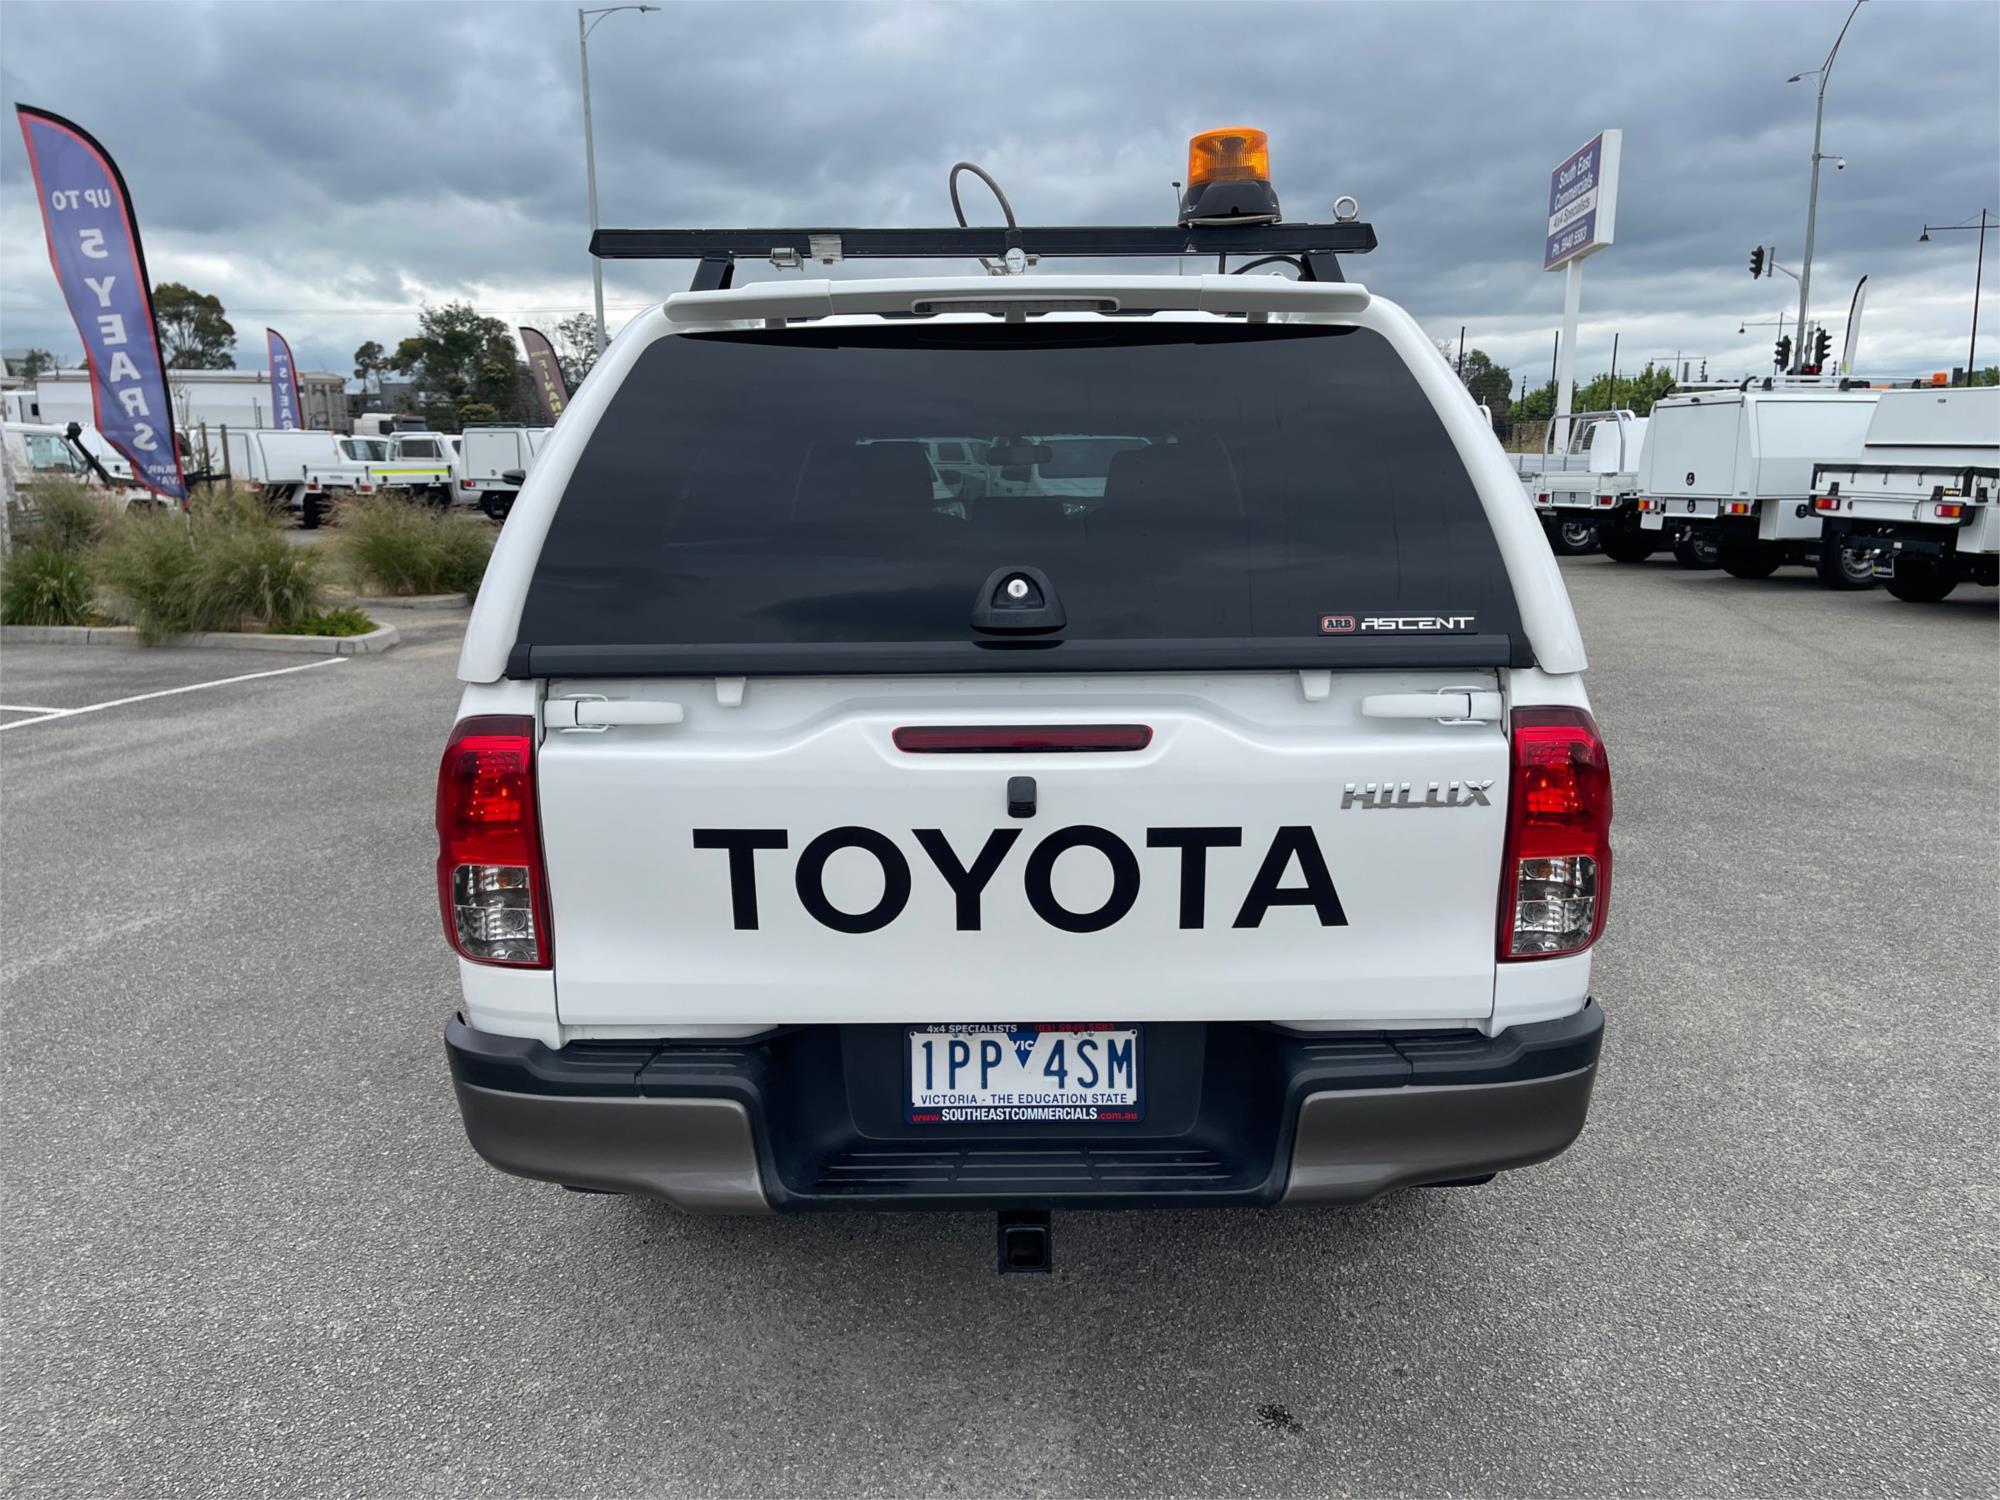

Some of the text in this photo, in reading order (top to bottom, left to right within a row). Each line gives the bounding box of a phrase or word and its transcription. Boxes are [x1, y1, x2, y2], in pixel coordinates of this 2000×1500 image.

[1559, 151, 1593, 189] South East
[1554, 173, 1593, 211] Commercials
[1326, 617, 1474, 630] ARB ASCENT
[1341, 779, 1495, 809] HILUX
[692, 825, 1349, 933] TOYOTA
[927, 1024, 1017, 1033] 4x4 SPECIALISTS
[1012, 1040, 1034, 1051] VIC
[921, 1039, 1133, 1090] 1PP 4SM
[921, 1094, 978, 1104] VICTORIA
[990, 1094, 1014, 1104] THE
[1018, 1094, 1089, 1104] EDUCATION
[1092, 1093, 1128, 1104] STATE
